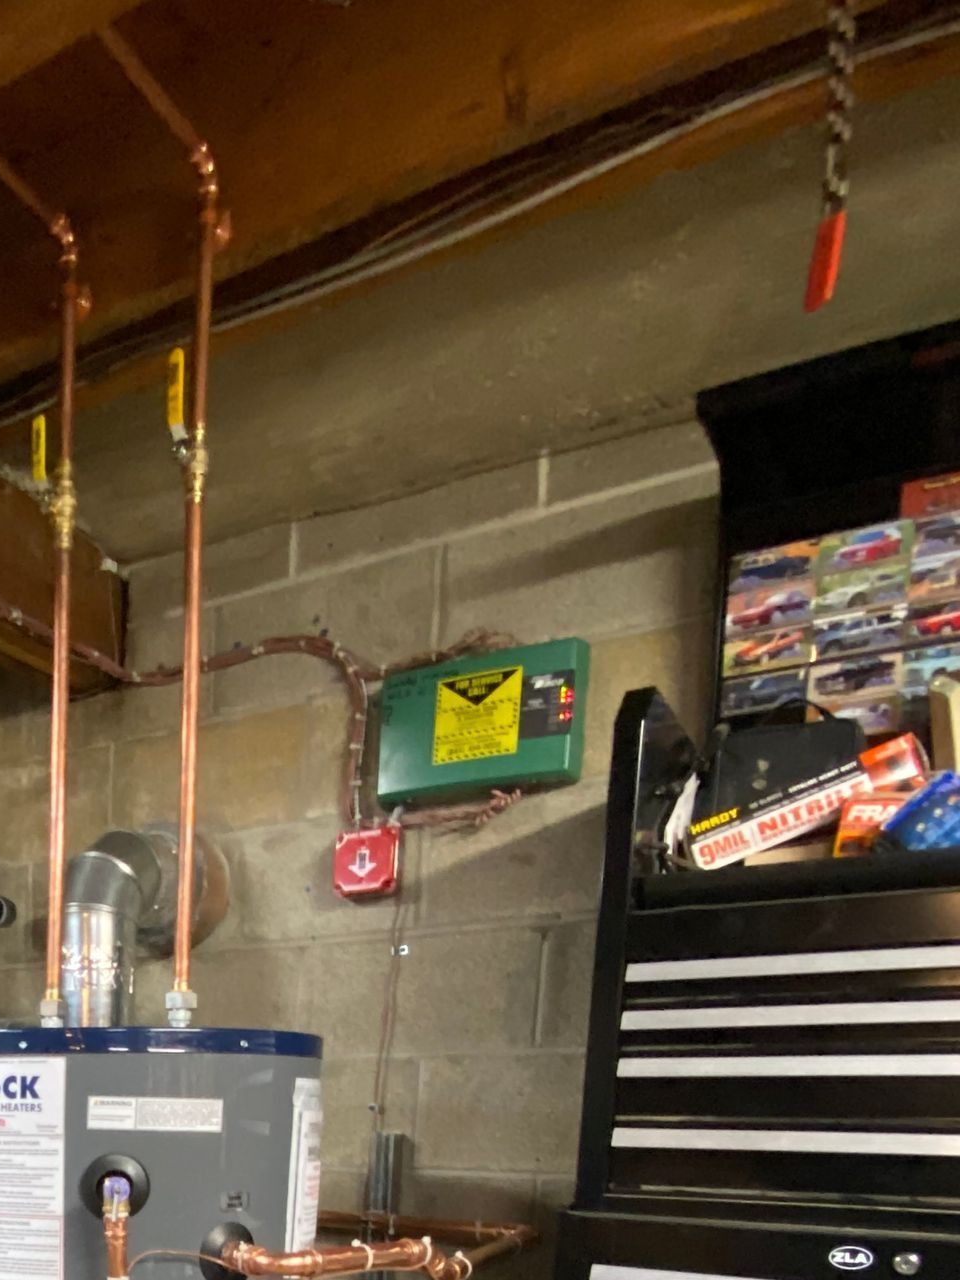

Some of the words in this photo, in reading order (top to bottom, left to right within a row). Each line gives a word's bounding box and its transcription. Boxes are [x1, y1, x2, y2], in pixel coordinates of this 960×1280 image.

[690, 808, 739, 835] HARDY
[848, 803, 900, 822] FRA
[699, 831, 749, 866] 9MIL
[0, 1104, 42, 1112] HEATERS
